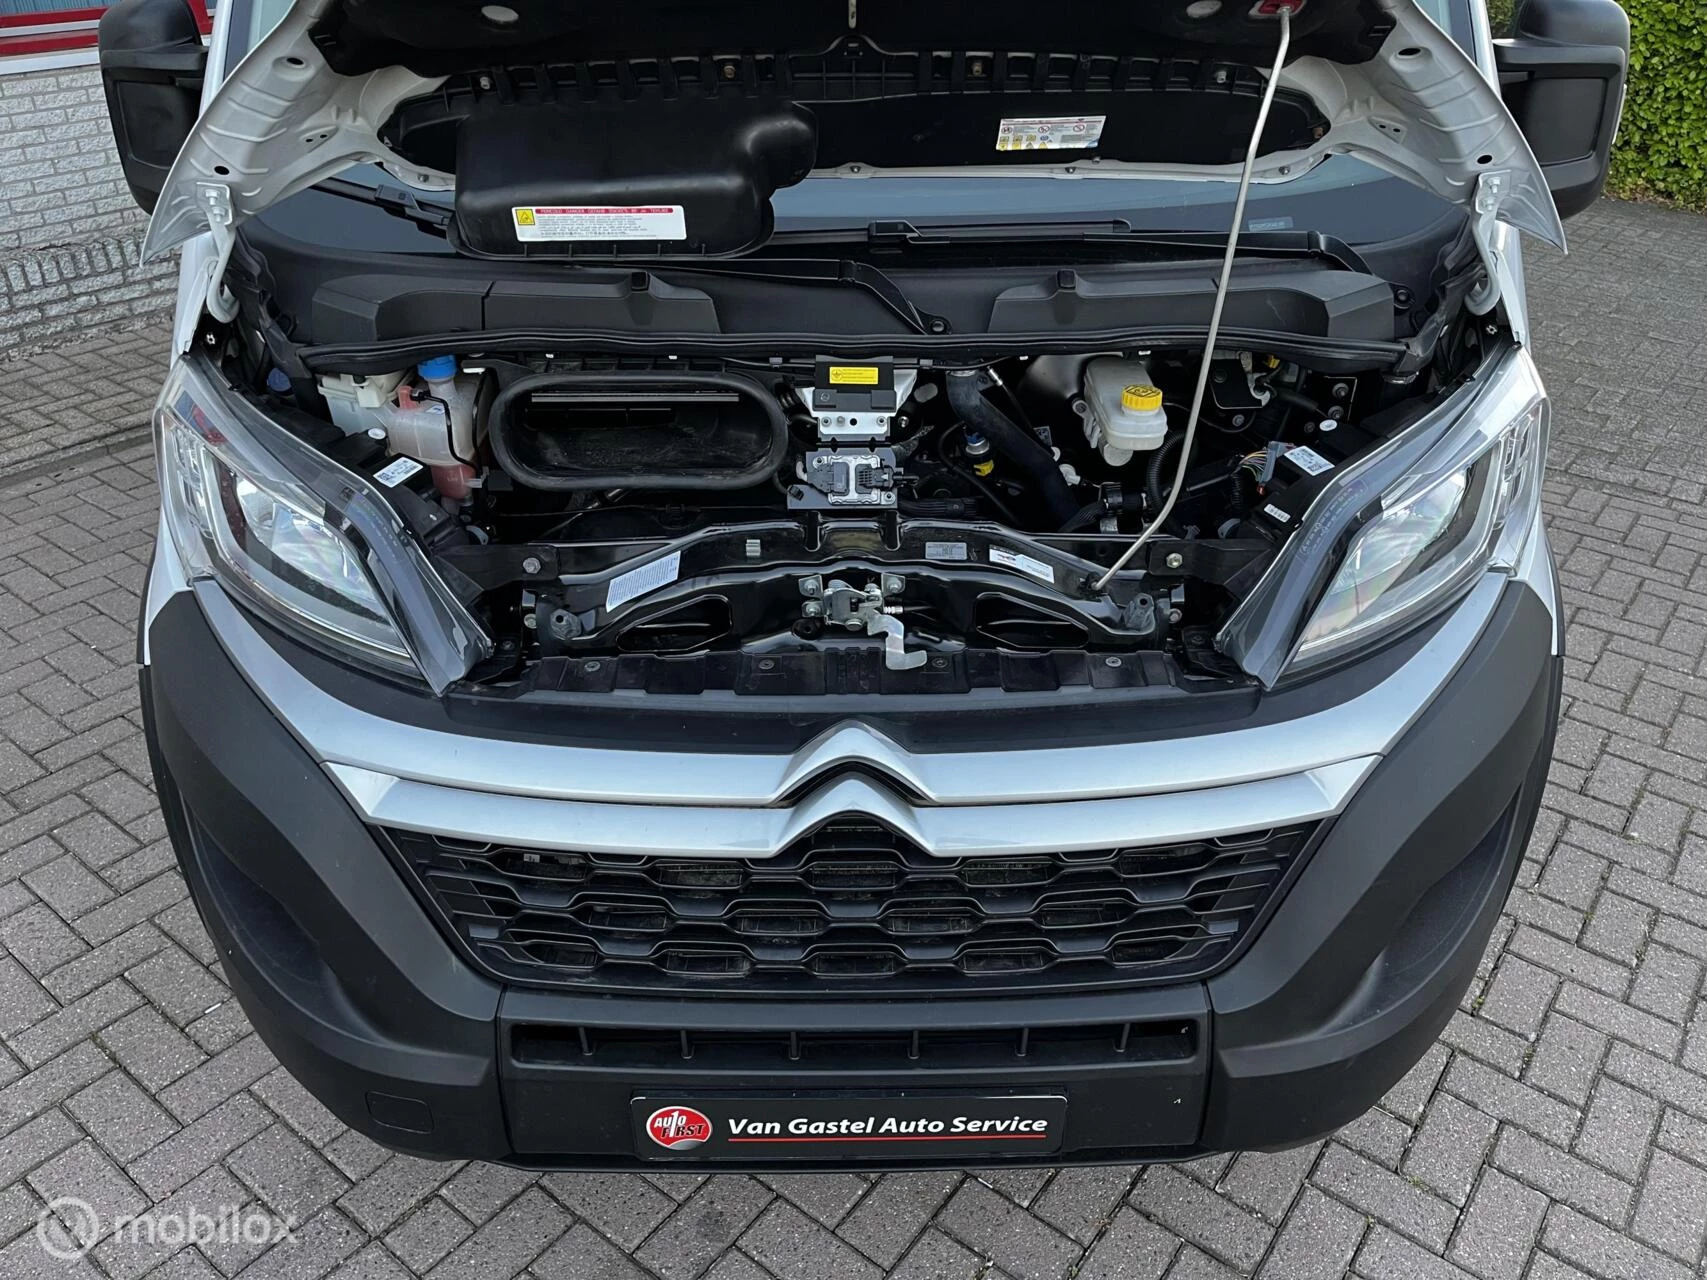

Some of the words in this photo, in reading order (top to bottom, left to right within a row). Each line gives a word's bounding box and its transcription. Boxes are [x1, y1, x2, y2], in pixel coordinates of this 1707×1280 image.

[728, 1118, 781, 1135] Van
[788, 1116, 875, 1135] Gastel
[878, 1116, 945, 1134] Auto
[950, 1116, 1048, 1132] Service
